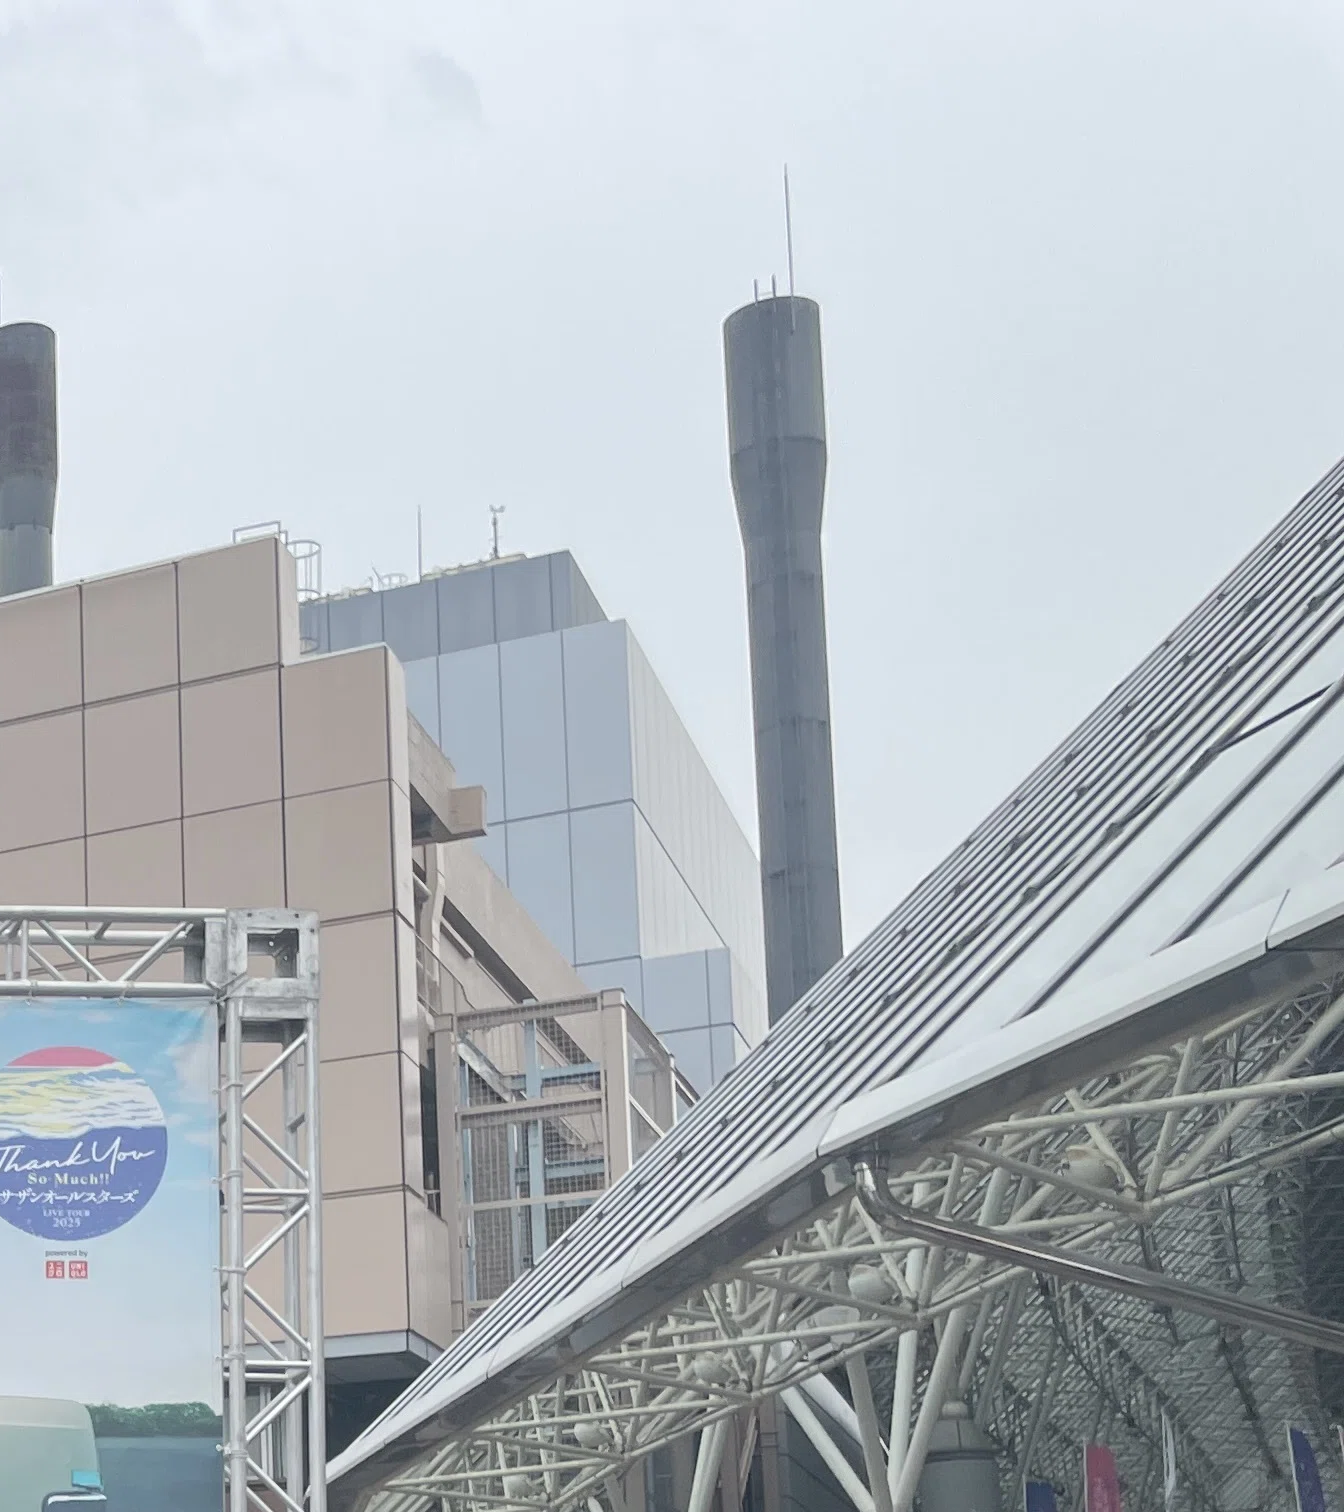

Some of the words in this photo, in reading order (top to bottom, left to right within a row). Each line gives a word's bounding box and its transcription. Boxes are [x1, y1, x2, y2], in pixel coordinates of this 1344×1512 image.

[91, 1136, 156, 1175] You
[27, 1172, 48, 1185] So
[54, 1172, 111, 1186] Much!!
[43, 1209, 63, 1217] LIVE
[53, 1217, 81, 1228] 2025
[45, 1250, 77, 1258] powered
[79, 1249, 89, 1258] by
